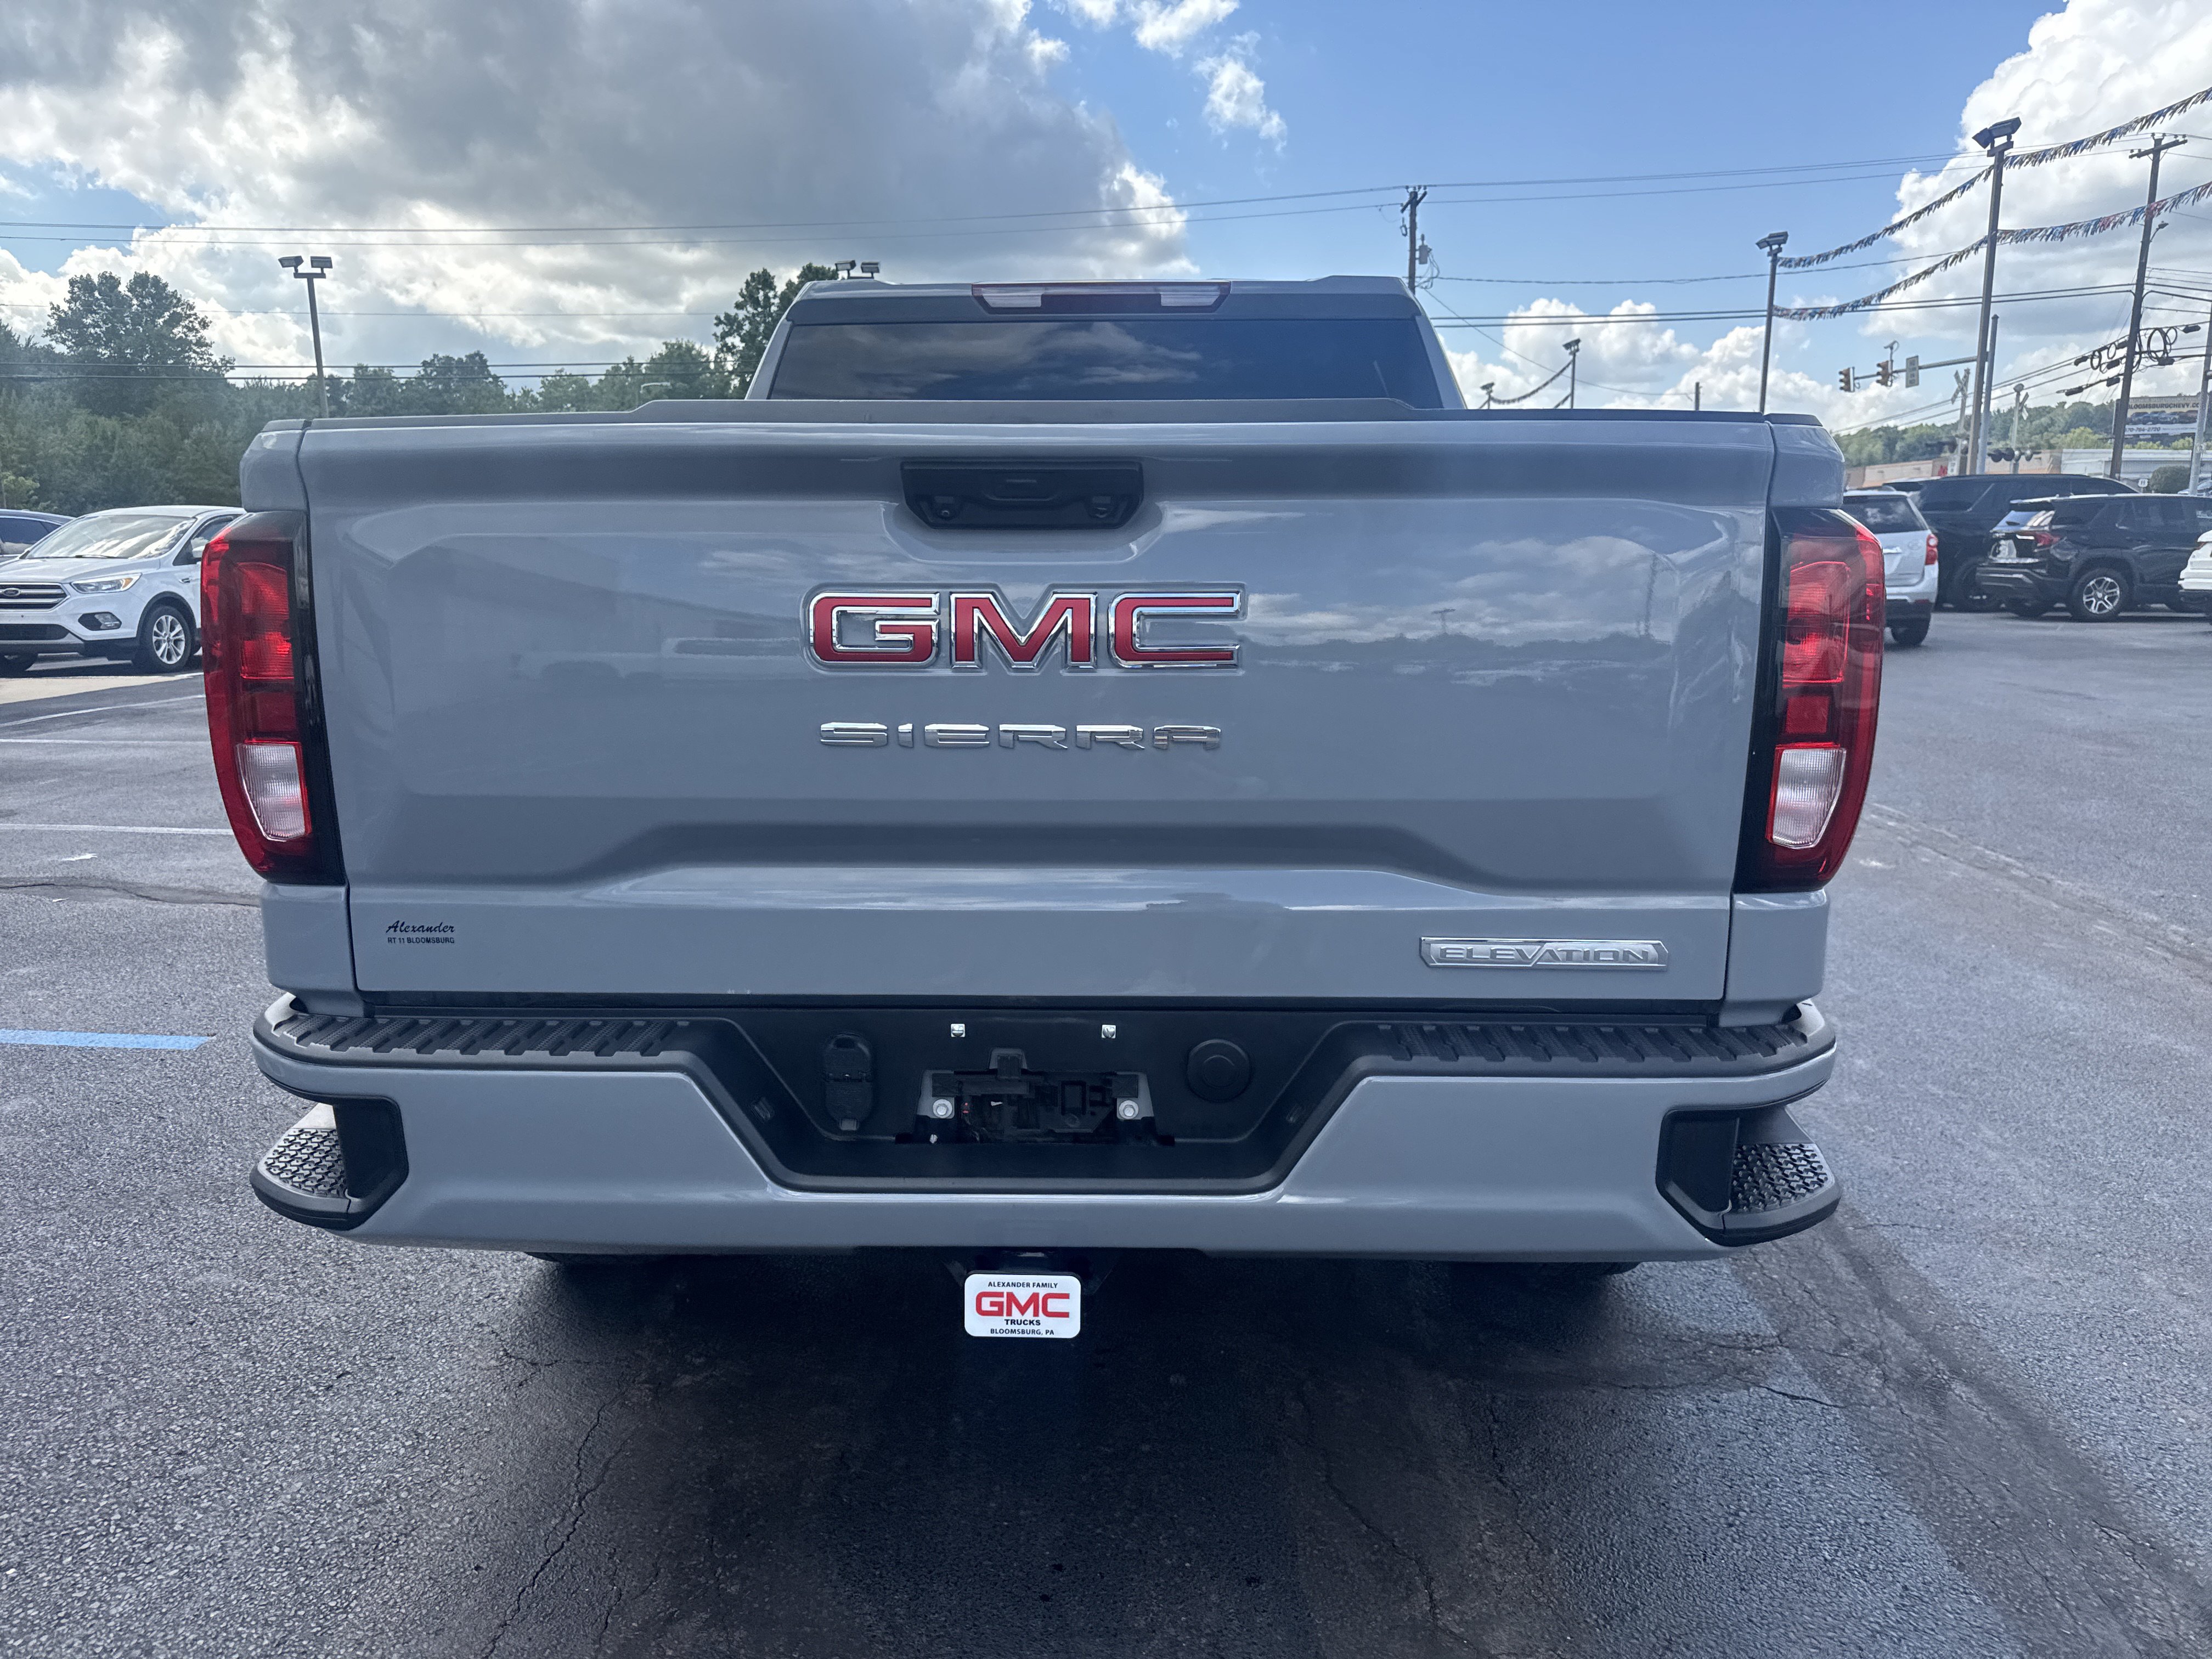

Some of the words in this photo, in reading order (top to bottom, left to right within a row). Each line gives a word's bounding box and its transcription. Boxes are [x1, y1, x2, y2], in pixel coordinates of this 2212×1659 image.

[810, 591, 1241, 669] GMC
[820, 721, 1221, 749] SIERRA
[386, 920, 455, 933] Alexander
[1440, 947, 1648, 962] ELEVATION
[975, 1291, 1070, 1318] GMC
